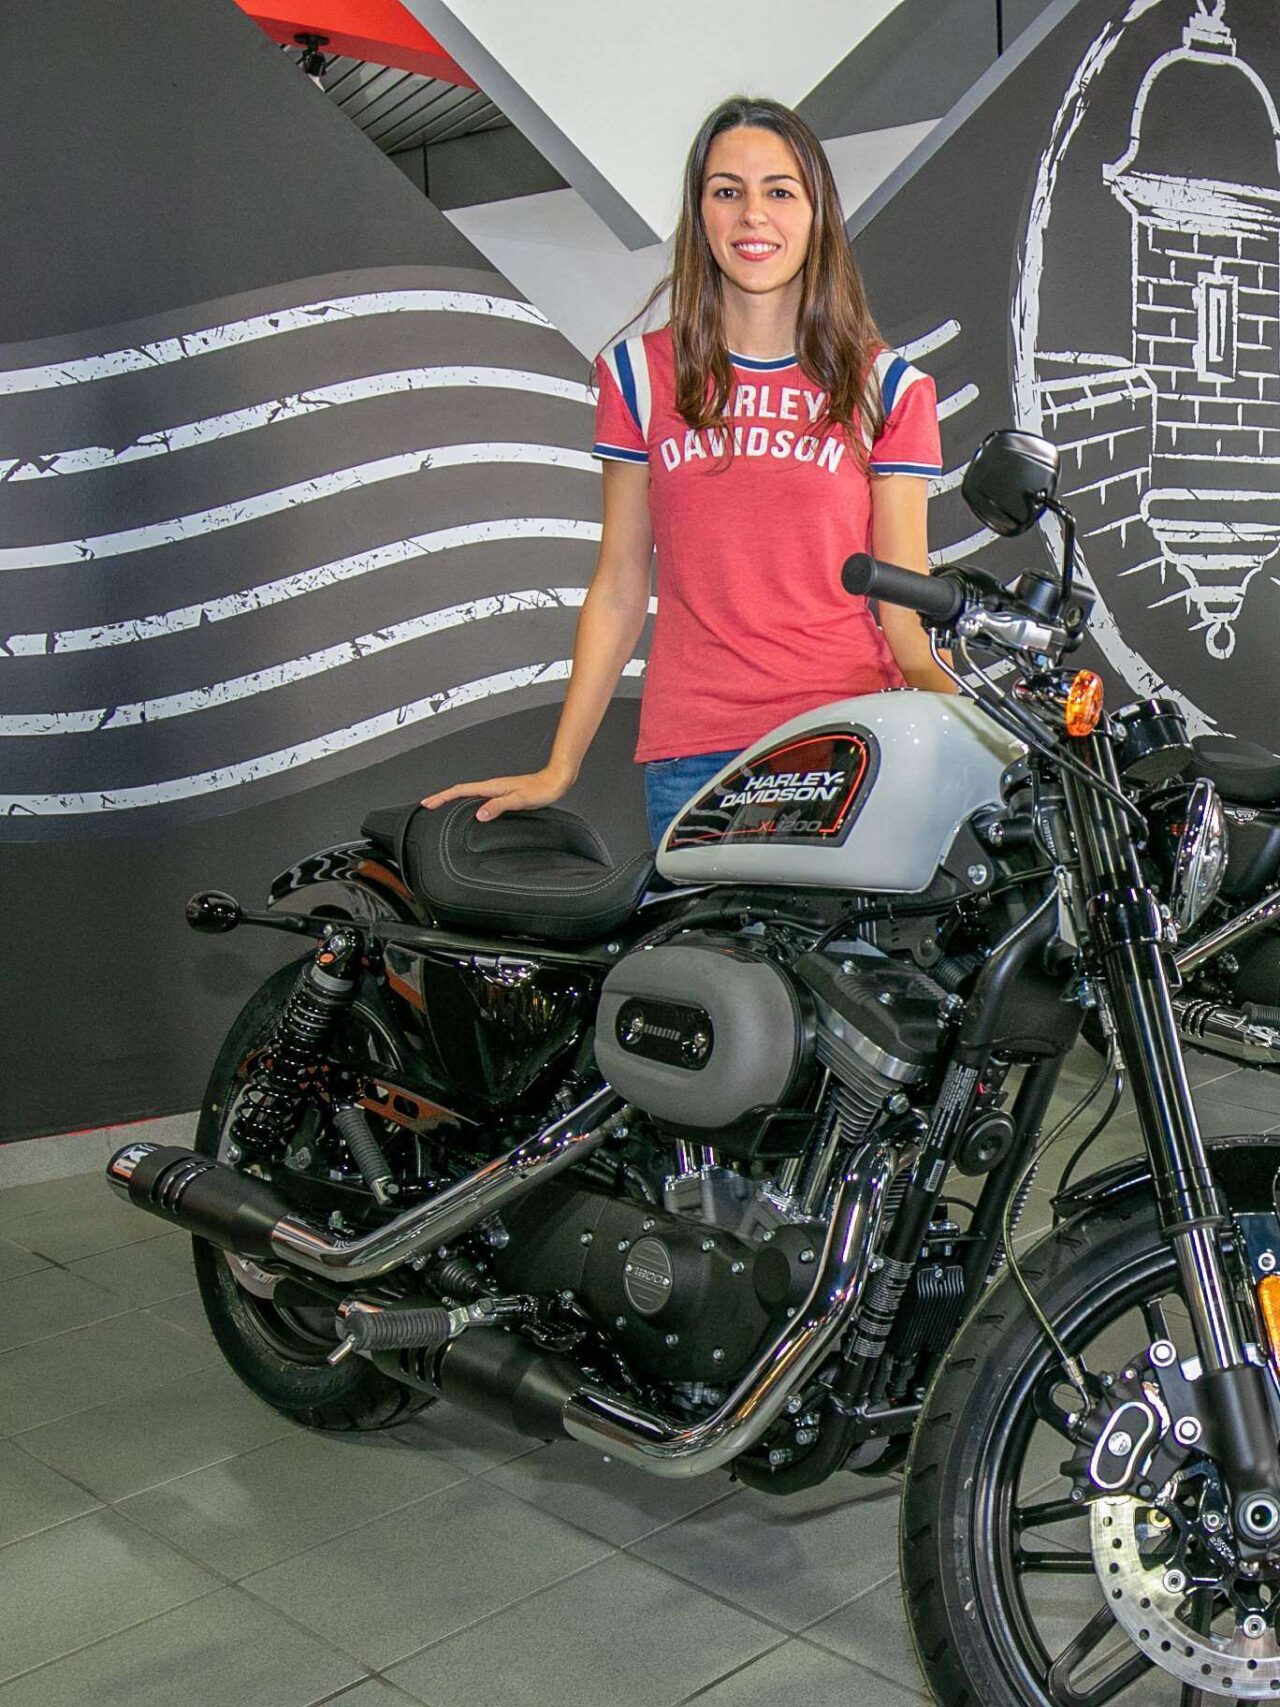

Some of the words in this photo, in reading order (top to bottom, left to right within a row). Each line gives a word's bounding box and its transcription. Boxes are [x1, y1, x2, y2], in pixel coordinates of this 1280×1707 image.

[720, 384, 830, 423] RLEY
[661, 426, 845, 474] DAVIDSON
[744, 771, 845, 790] HARLEY-
[719, 787, 838, 809] DAVIDSON
